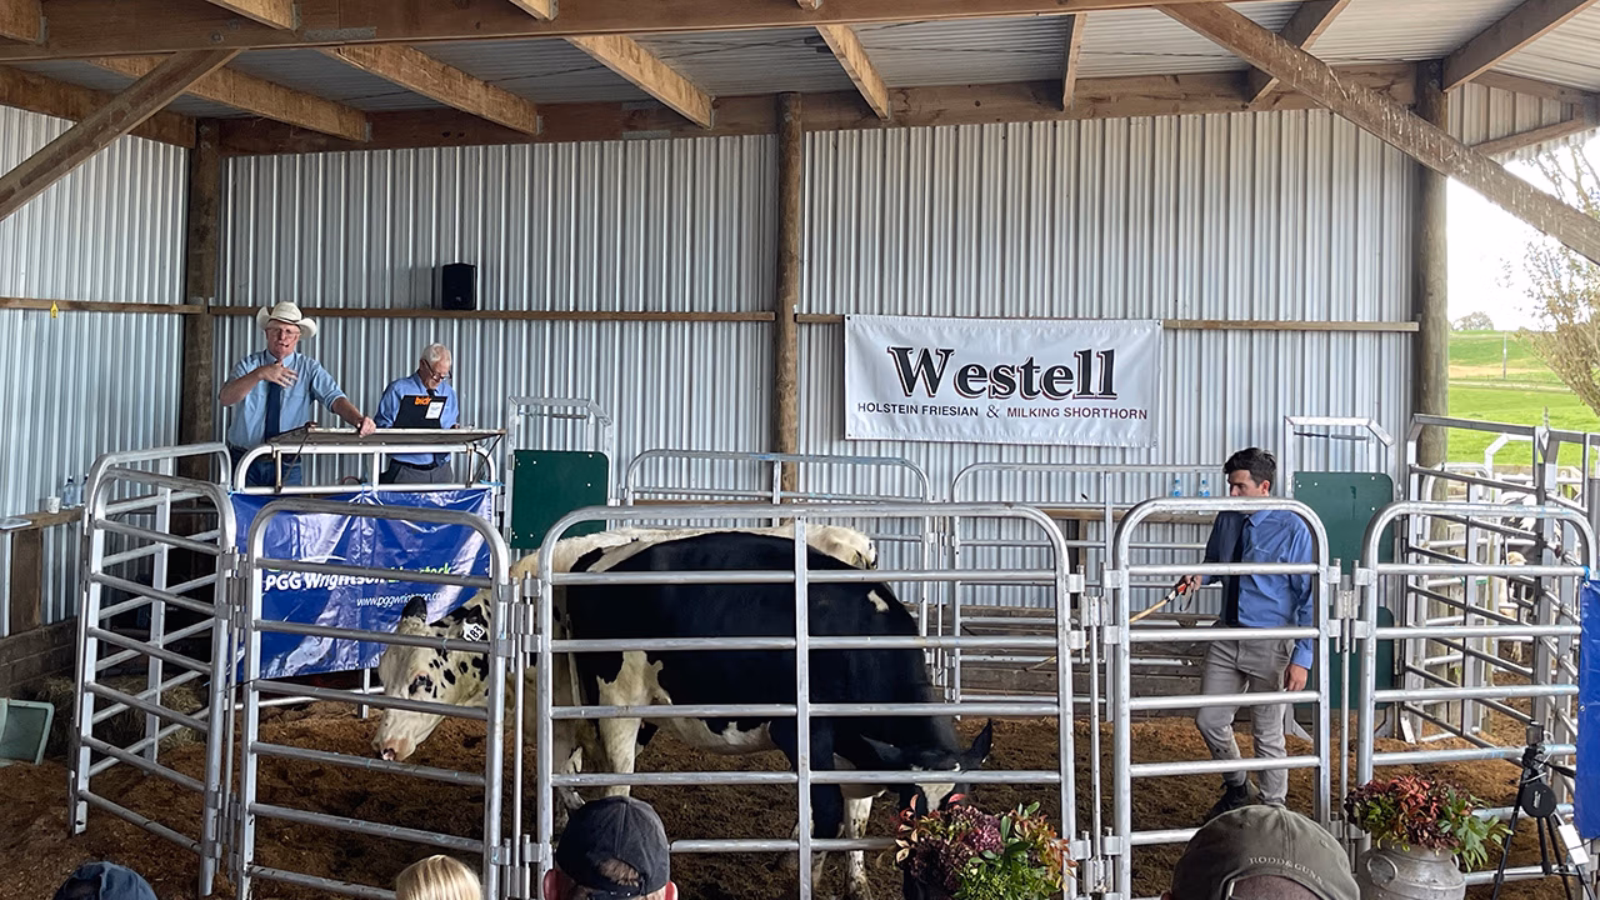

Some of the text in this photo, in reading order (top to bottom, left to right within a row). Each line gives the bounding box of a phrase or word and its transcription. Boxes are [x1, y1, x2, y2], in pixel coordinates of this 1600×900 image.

[887, 346, 1118, 400] Westell
[857, 402, 1148, 420] HOLSTEIN FRIESIAN & MILKING SHORTHORN
[264, 573, 302, 591] PGG
[465, 625, 484, 642] 183
